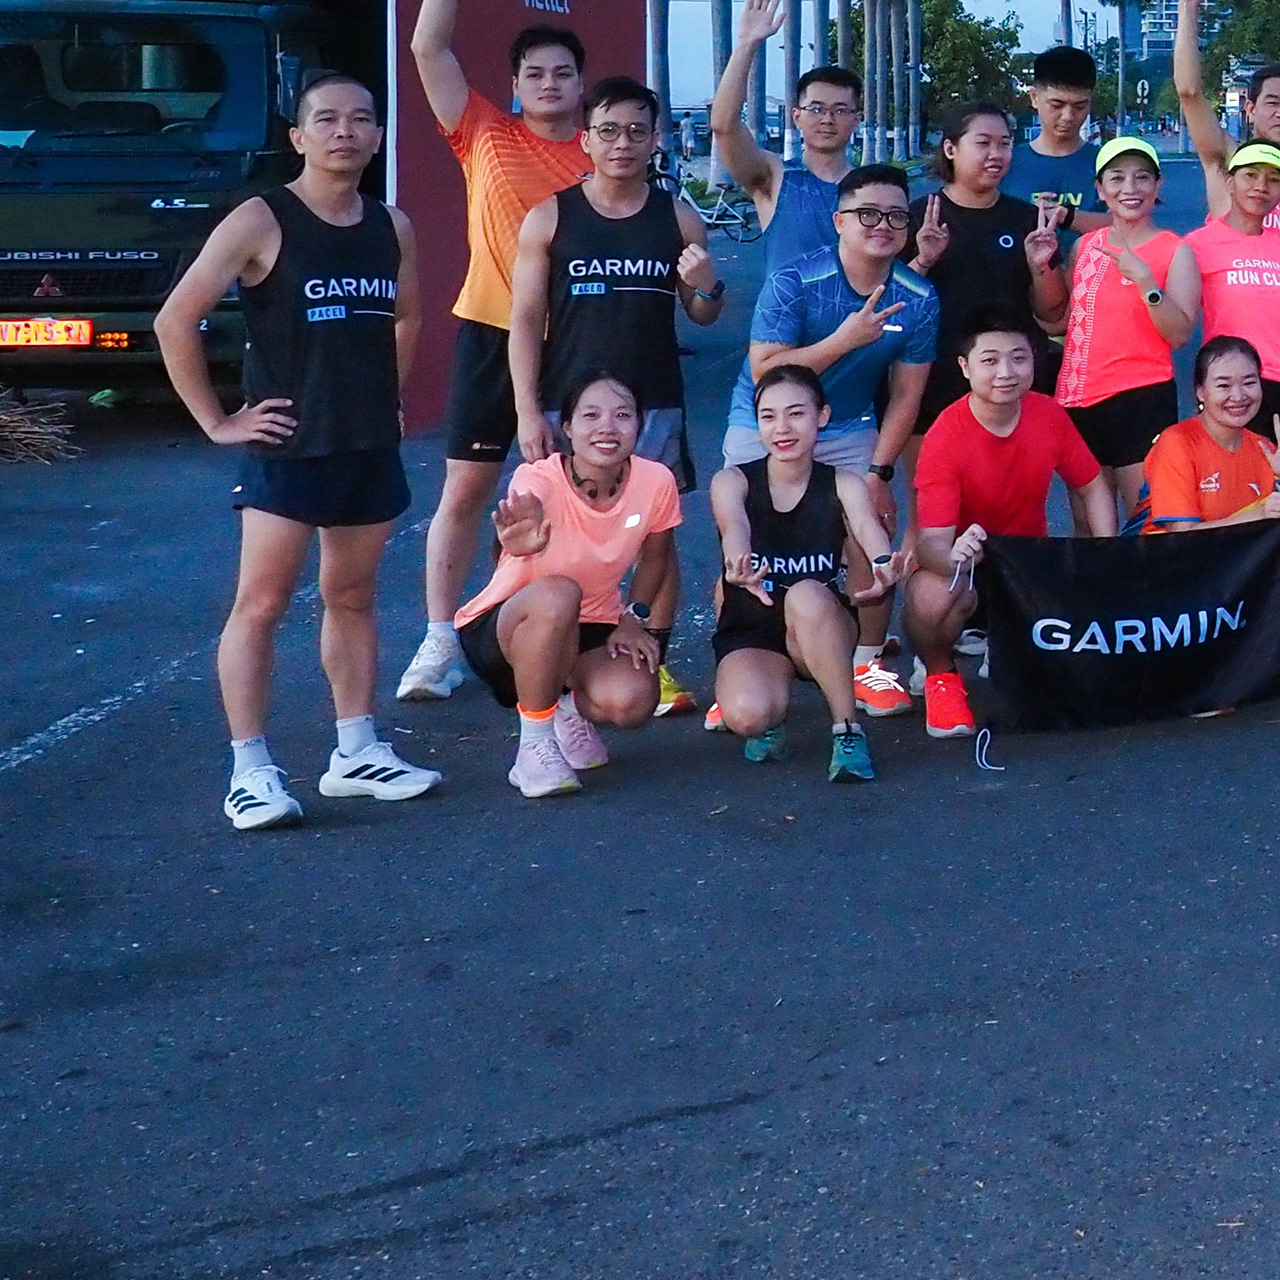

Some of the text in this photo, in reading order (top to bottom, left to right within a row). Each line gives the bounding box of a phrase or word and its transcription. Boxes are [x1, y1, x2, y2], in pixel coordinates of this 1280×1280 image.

[88, 251, 160, 261] FUSO
[568, 259, 671, 278] GARMIN
[1226, 270, 1261, 286] RUN
[1032, 600, 1245, 655] GARMIN
